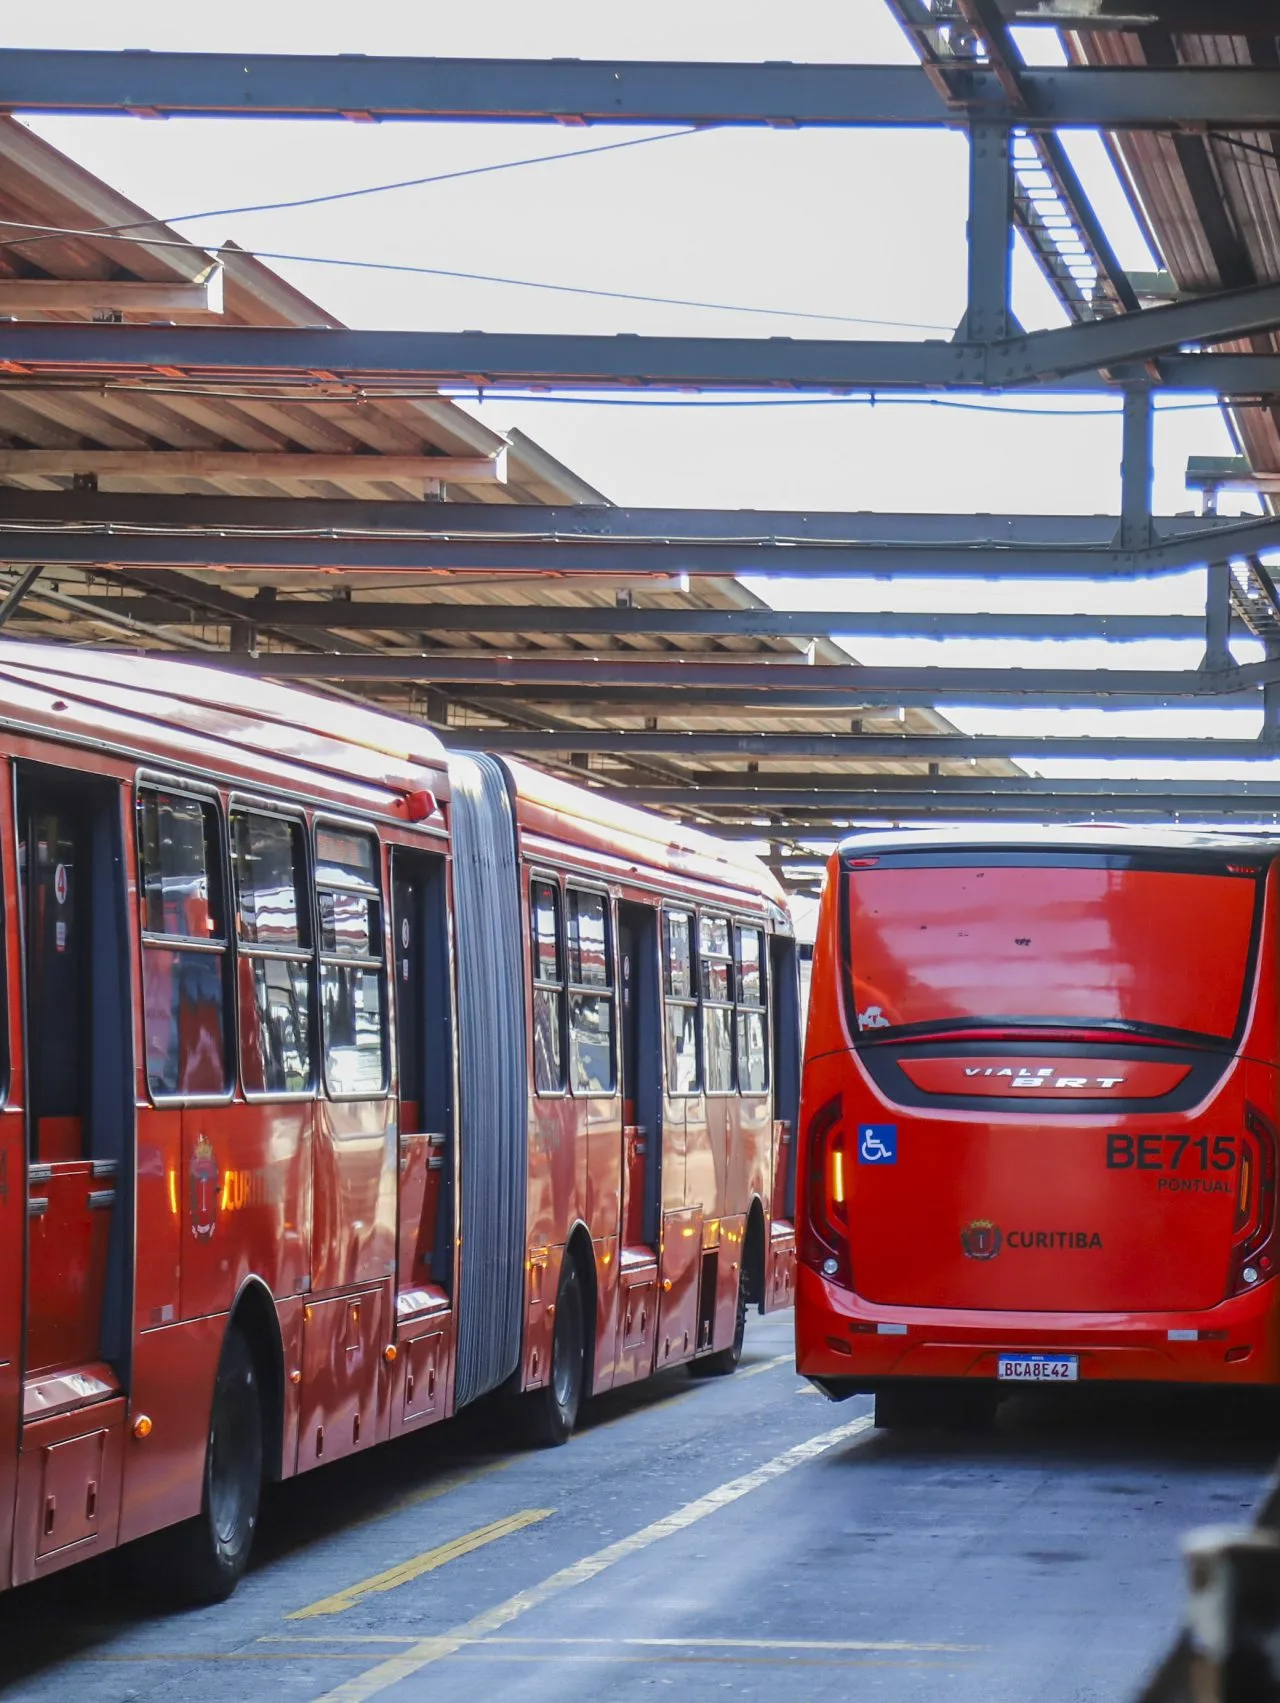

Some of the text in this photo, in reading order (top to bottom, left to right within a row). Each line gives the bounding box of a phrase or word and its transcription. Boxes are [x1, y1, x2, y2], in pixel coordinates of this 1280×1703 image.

[964, 1067, 1055, 1077] VIALE
[1010, 1076, 1125, 1089] BRT
[1105, 1133, 1237, 1172] BE715
[1157, 1178, 1233, 1193] PONTUAL
[1005, 1230, 1104, 1249] CURITIBA
[1004, 1362, 1070, 1378] BCA8E42
